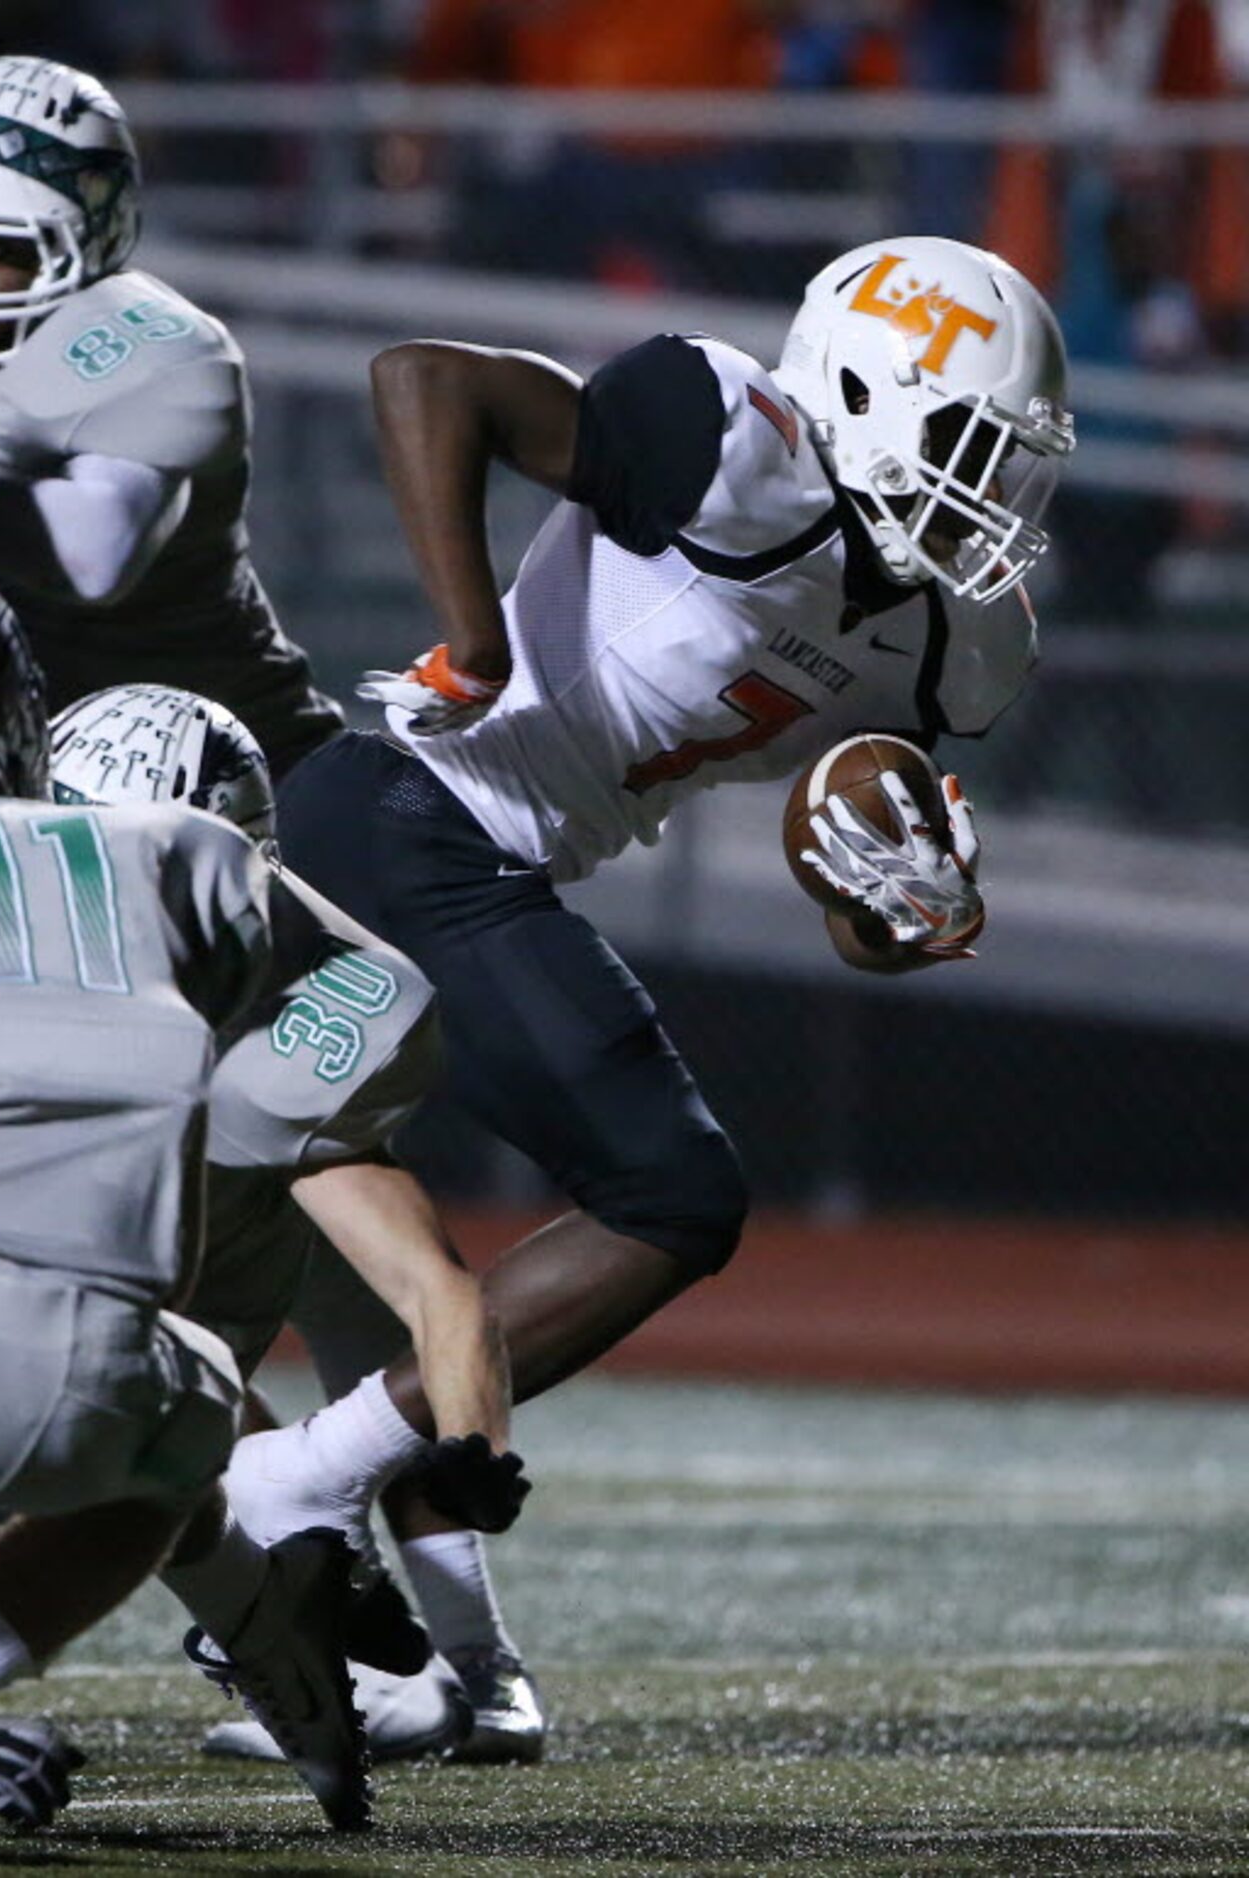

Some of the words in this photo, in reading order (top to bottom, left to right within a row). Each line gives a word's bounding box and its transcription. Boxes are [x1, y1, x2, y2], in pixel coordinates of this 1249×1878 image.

[63, 301, 194, 381] 85
[766, 626, 857, 695] LANCASTER
[622, 669, 817, 797] 7
[270, 952, 399, 1085] 30
